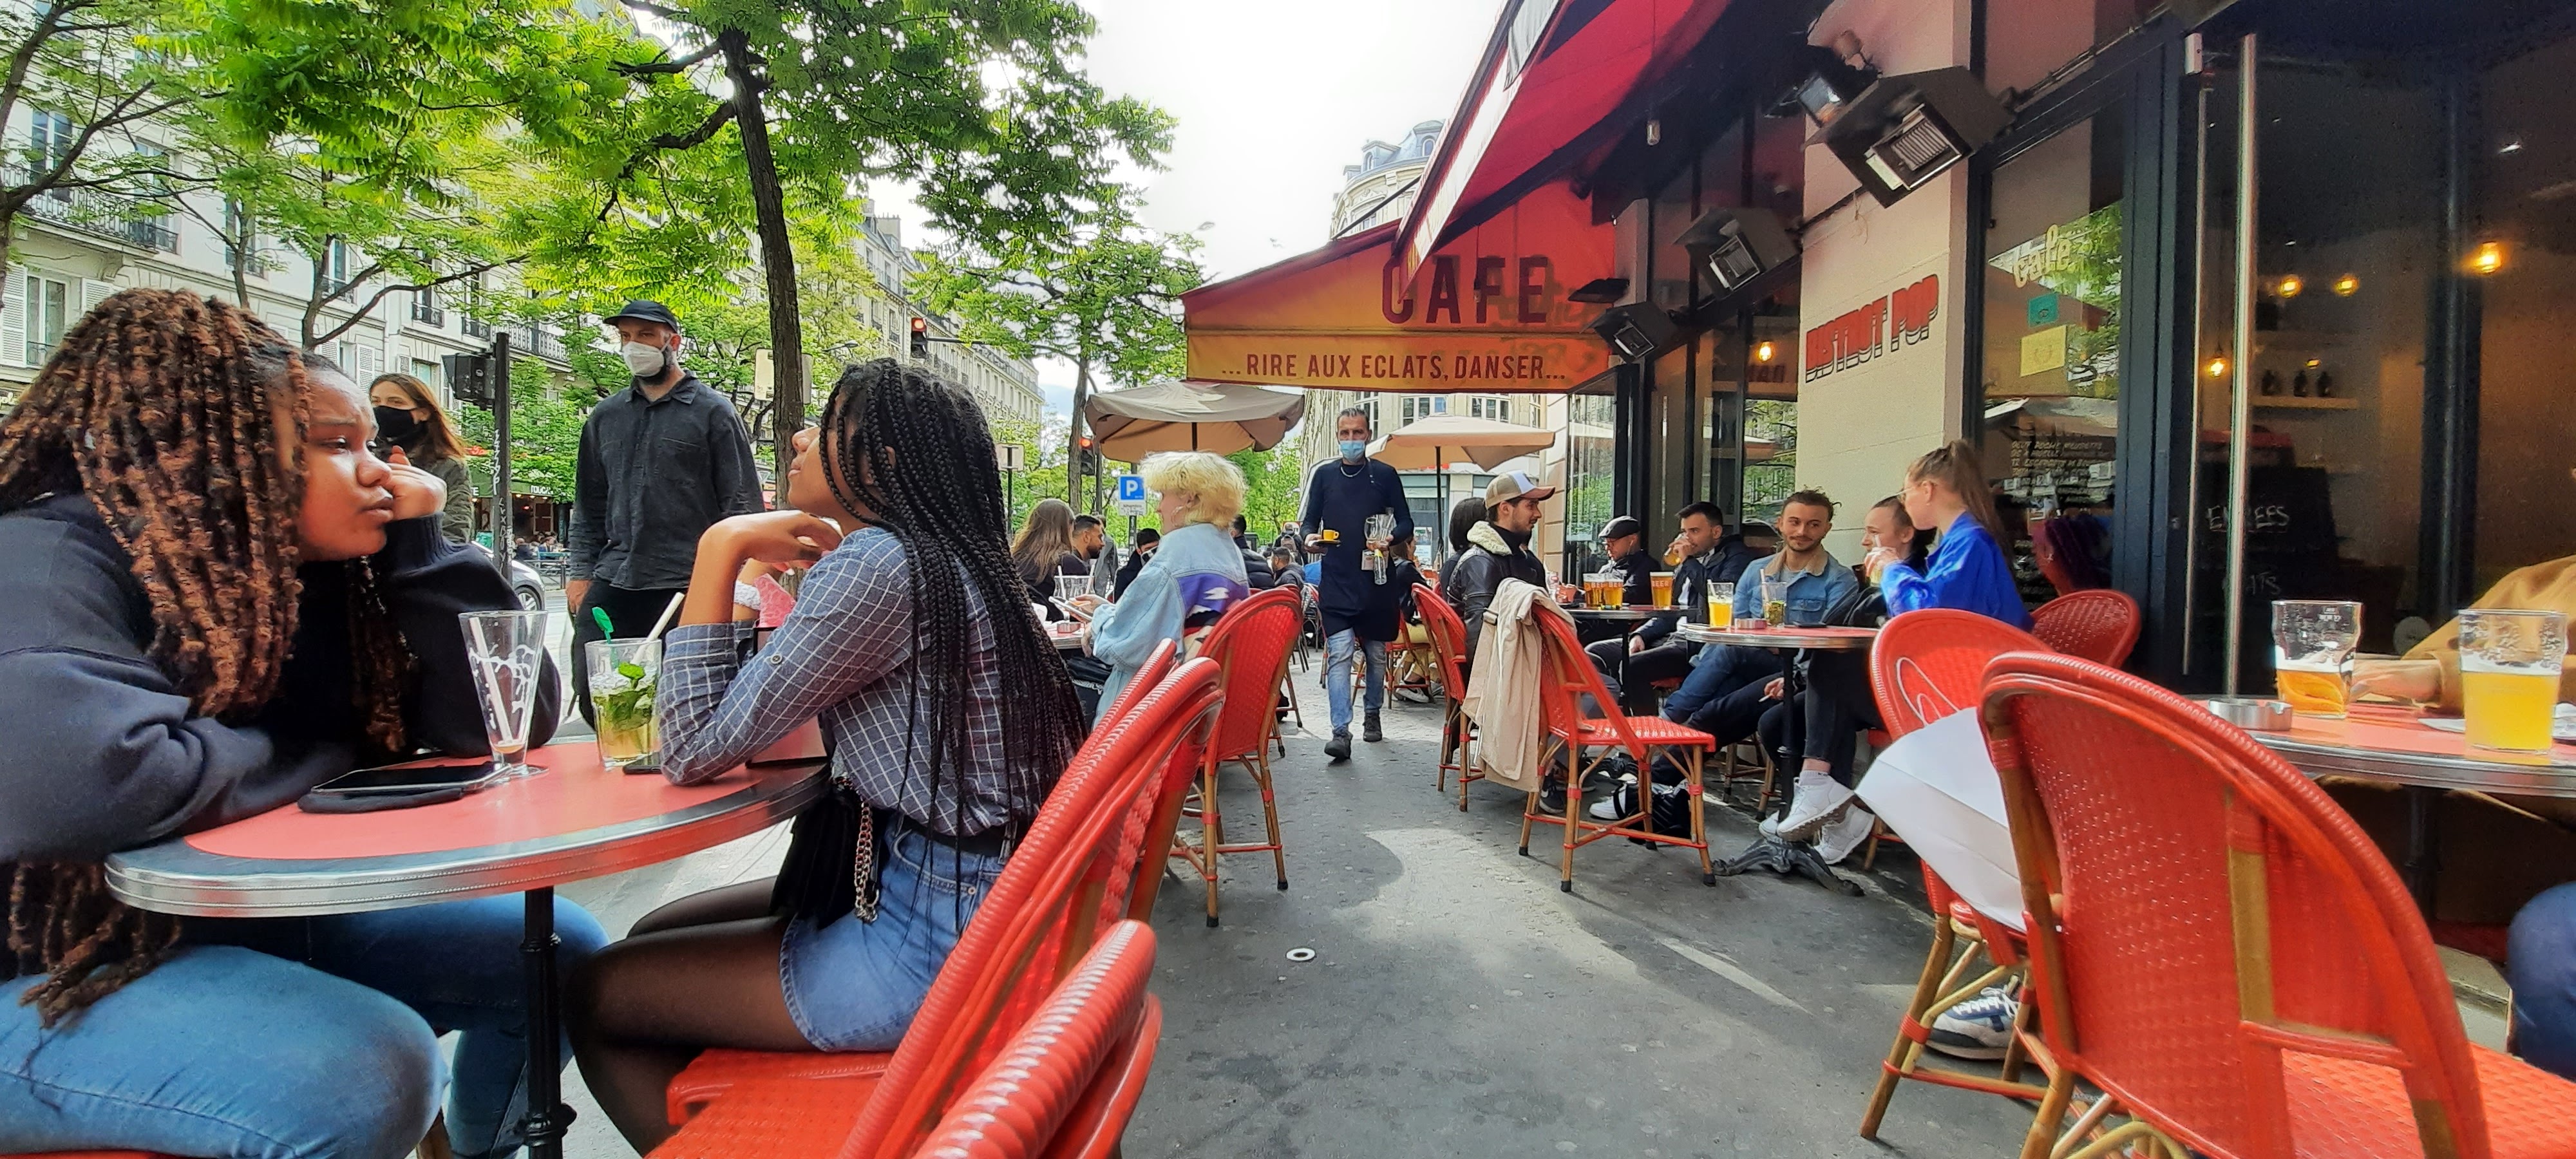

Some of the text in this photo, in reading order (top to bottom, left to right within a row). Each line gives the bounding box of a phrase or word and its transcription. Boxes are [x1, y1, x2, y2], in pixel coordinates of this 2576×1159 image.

[1382, 256, 1548, 324] CAFE
[1890, 274, 1939, 352] POP
[1308, 354, 1350, 378] AUX
[1361, 355, 1448, 382] ECLATS,
[1126, 480, 1139, 497] P
